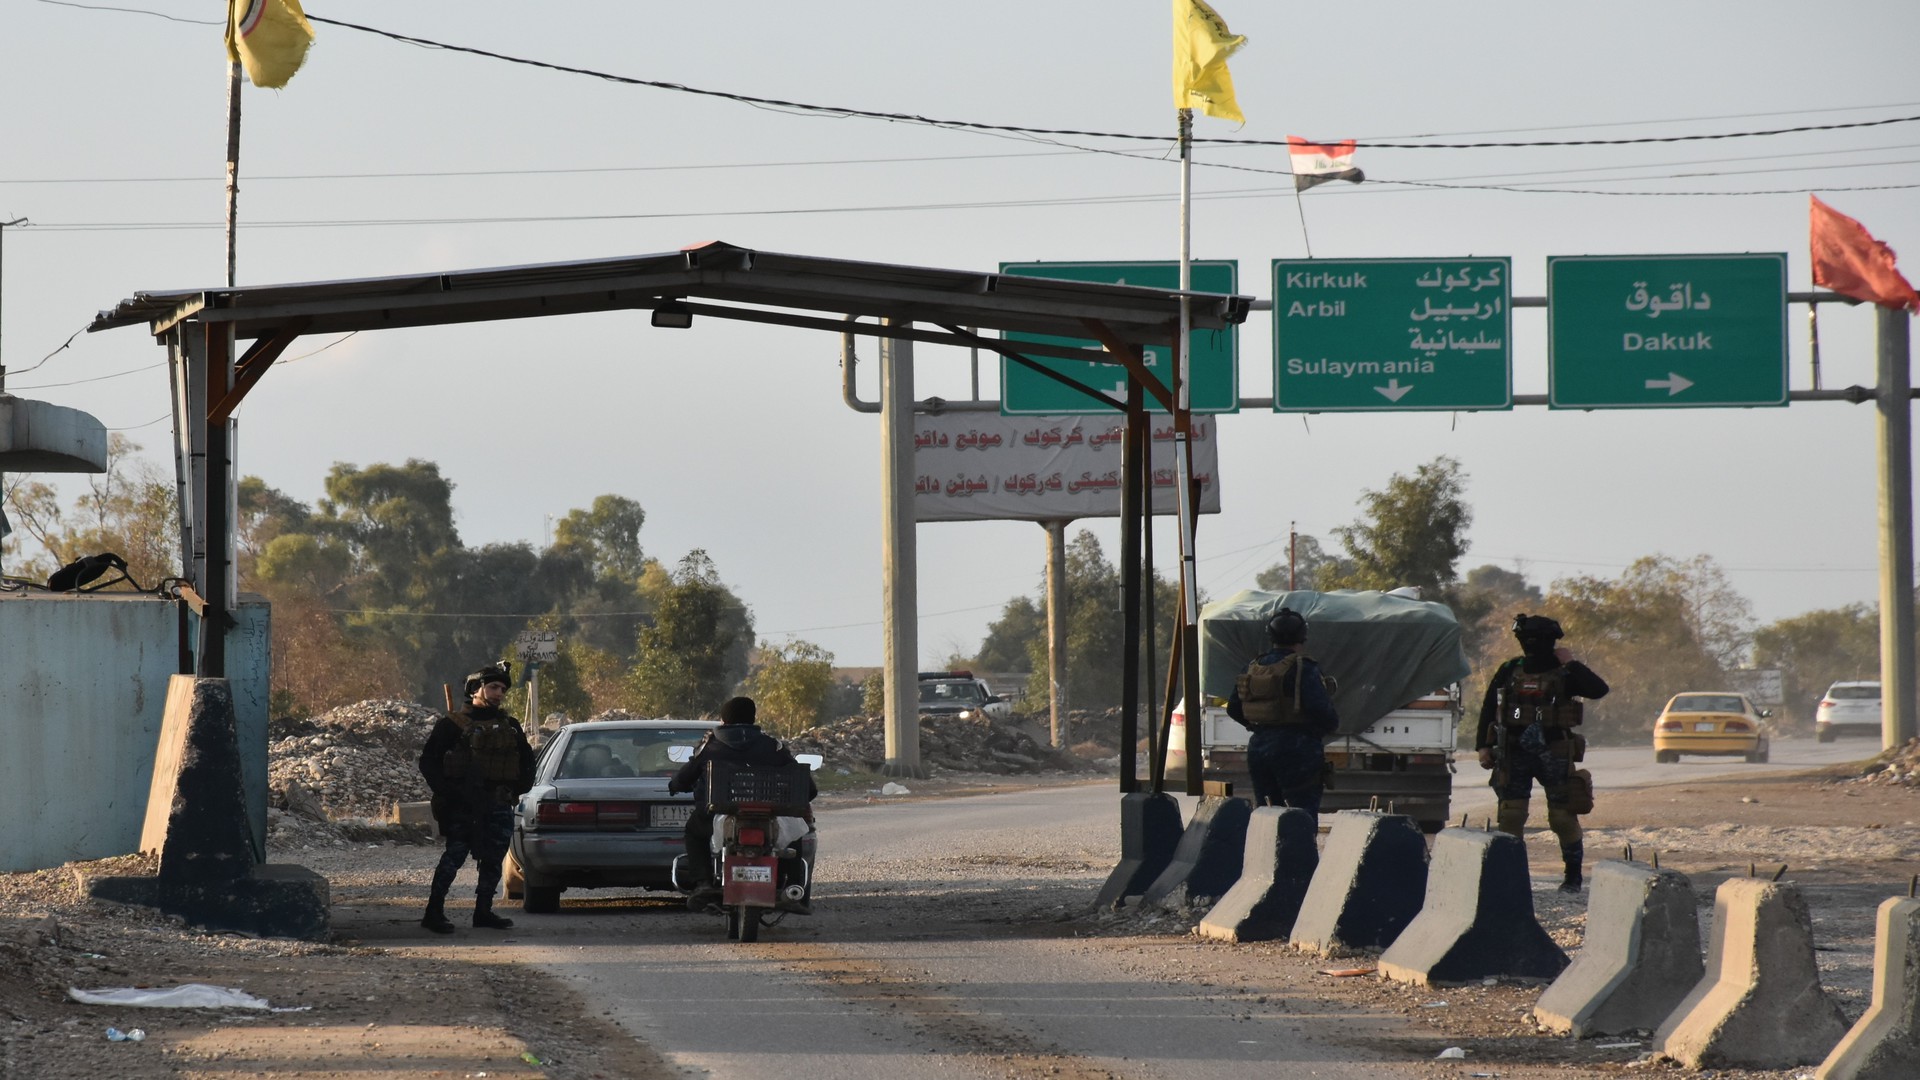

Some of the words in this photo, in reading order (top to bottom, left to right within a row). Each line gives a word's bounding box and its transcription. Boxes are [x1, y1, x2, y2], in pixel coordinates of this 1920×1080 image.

[1286, 272, 1368, 289] Kirkuk
[1416, 266, 1501, 293] كركوك
[1287, 299, 1346, 317] Arbil
[1410, 296, 1501, 322] اربيل
[1625, 281, 1712, 318] داقوق
[1408, 327, 1501, 357] سليمانية
[1623, 331, 1712, 351] Dakuk
[1286, 357, 1435, 378] Sulaymania
[955, 429, 1003, 451] موقع
[1023, 426, 1083, 449] كركوك
